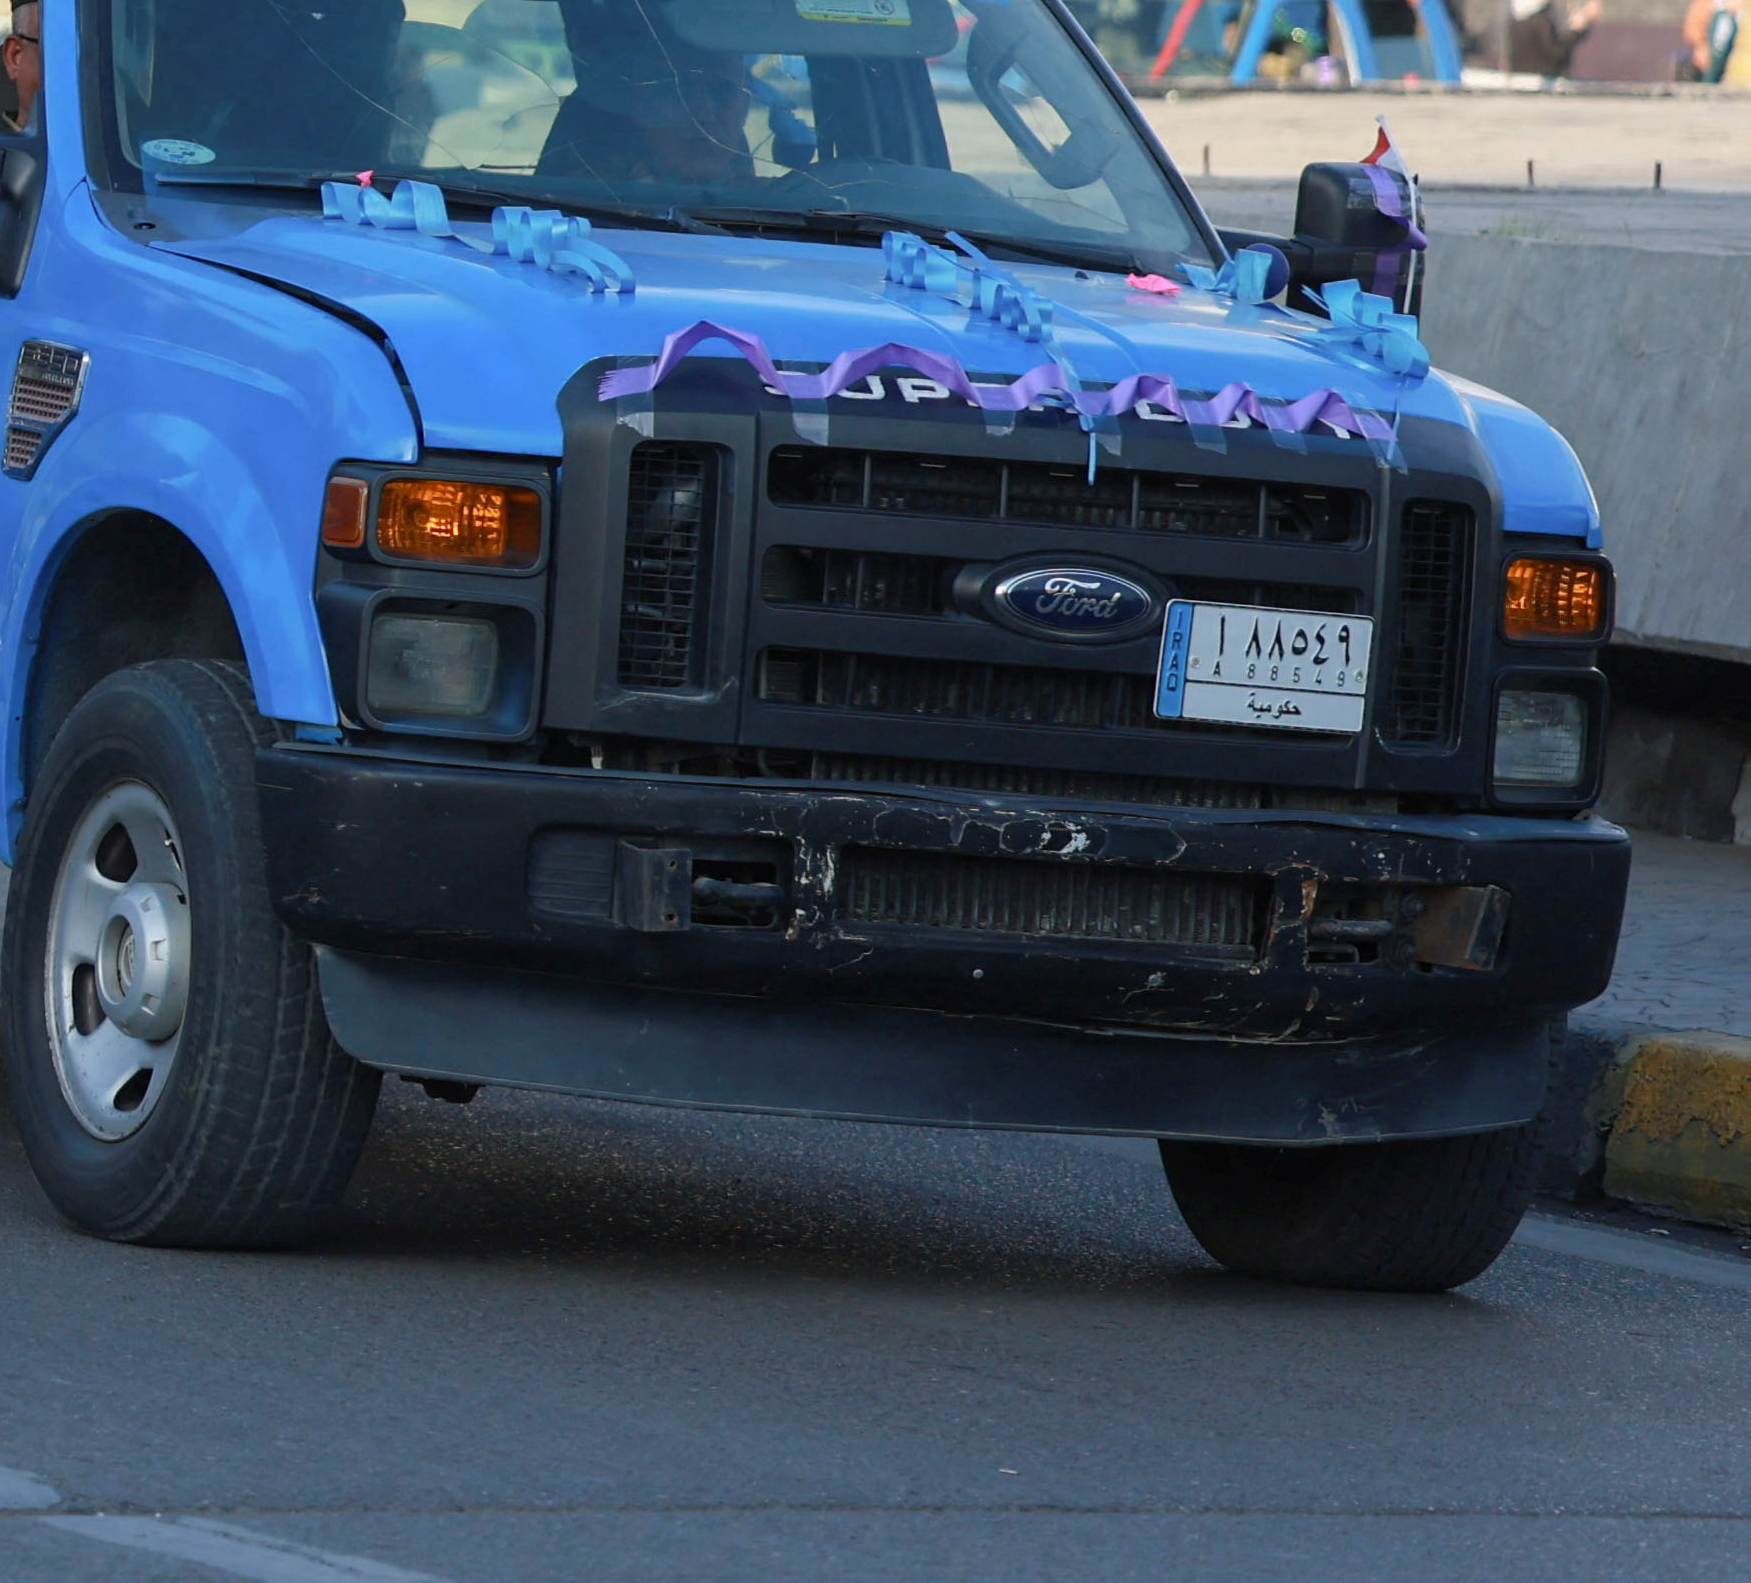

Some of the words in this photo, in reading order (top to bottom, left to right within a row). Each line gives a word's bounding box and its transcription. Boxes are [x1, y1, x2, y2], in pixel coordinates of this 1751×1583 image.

[1036, 577, 1122, 619] Ford
[1166, 610, 1183, 692] IRAQ
[1244, 616, 1352, 667] ٨٨٥٤٩
[1212, 661, 1222, 677] A
[1247, 692, 1301, 720] حكومية
